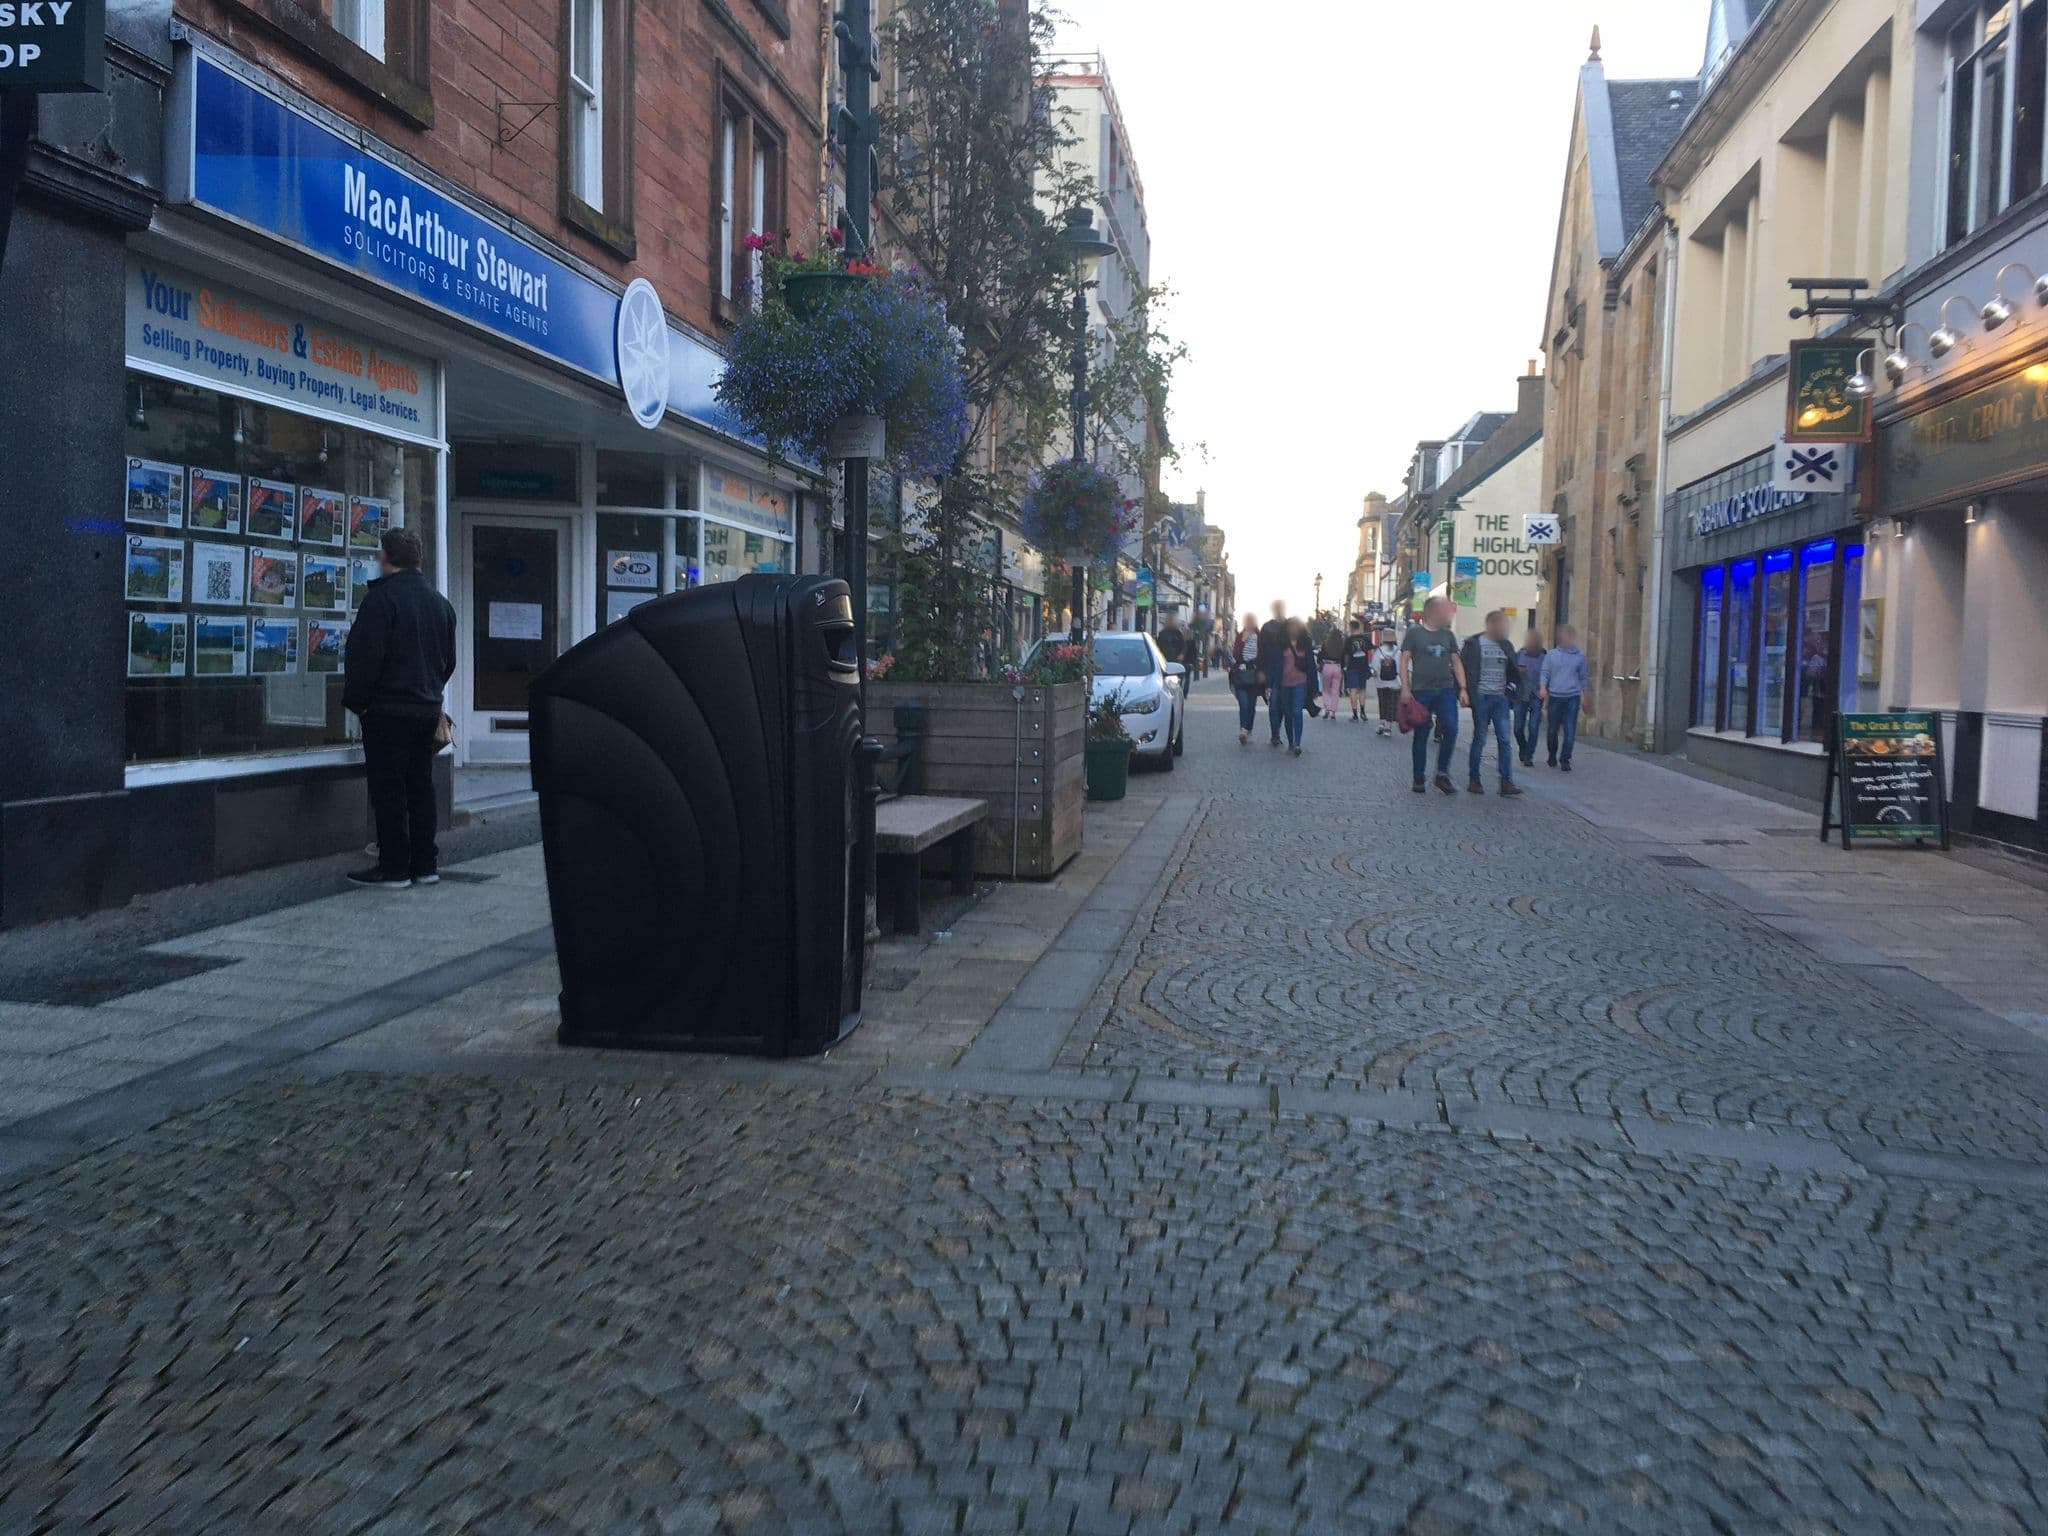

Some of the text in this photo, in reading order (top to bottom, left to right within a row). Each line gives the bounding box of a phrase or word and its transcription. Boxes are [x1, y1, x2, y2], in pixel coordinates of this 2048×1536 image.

[0, 2, 72, 27] SKY
[344, 163, 548, 312] MacArthur Stewart
[344, 225, 549, 336] SOLICITORS & ESTATE AGENTS
[141, 270, 419, 395] Your Solicitors & Estate Agents
[143, 322, 190, 361] Selling
[257, 357, 296, 390] Buying
[350, 387, 377, 410] Legal
[379, 395, 421, 423] Services.
[1475, 515, 1509, 531] THE
[1703, 499, 1730, 533] BANK
[1730, 491, 1746, 523] OF
